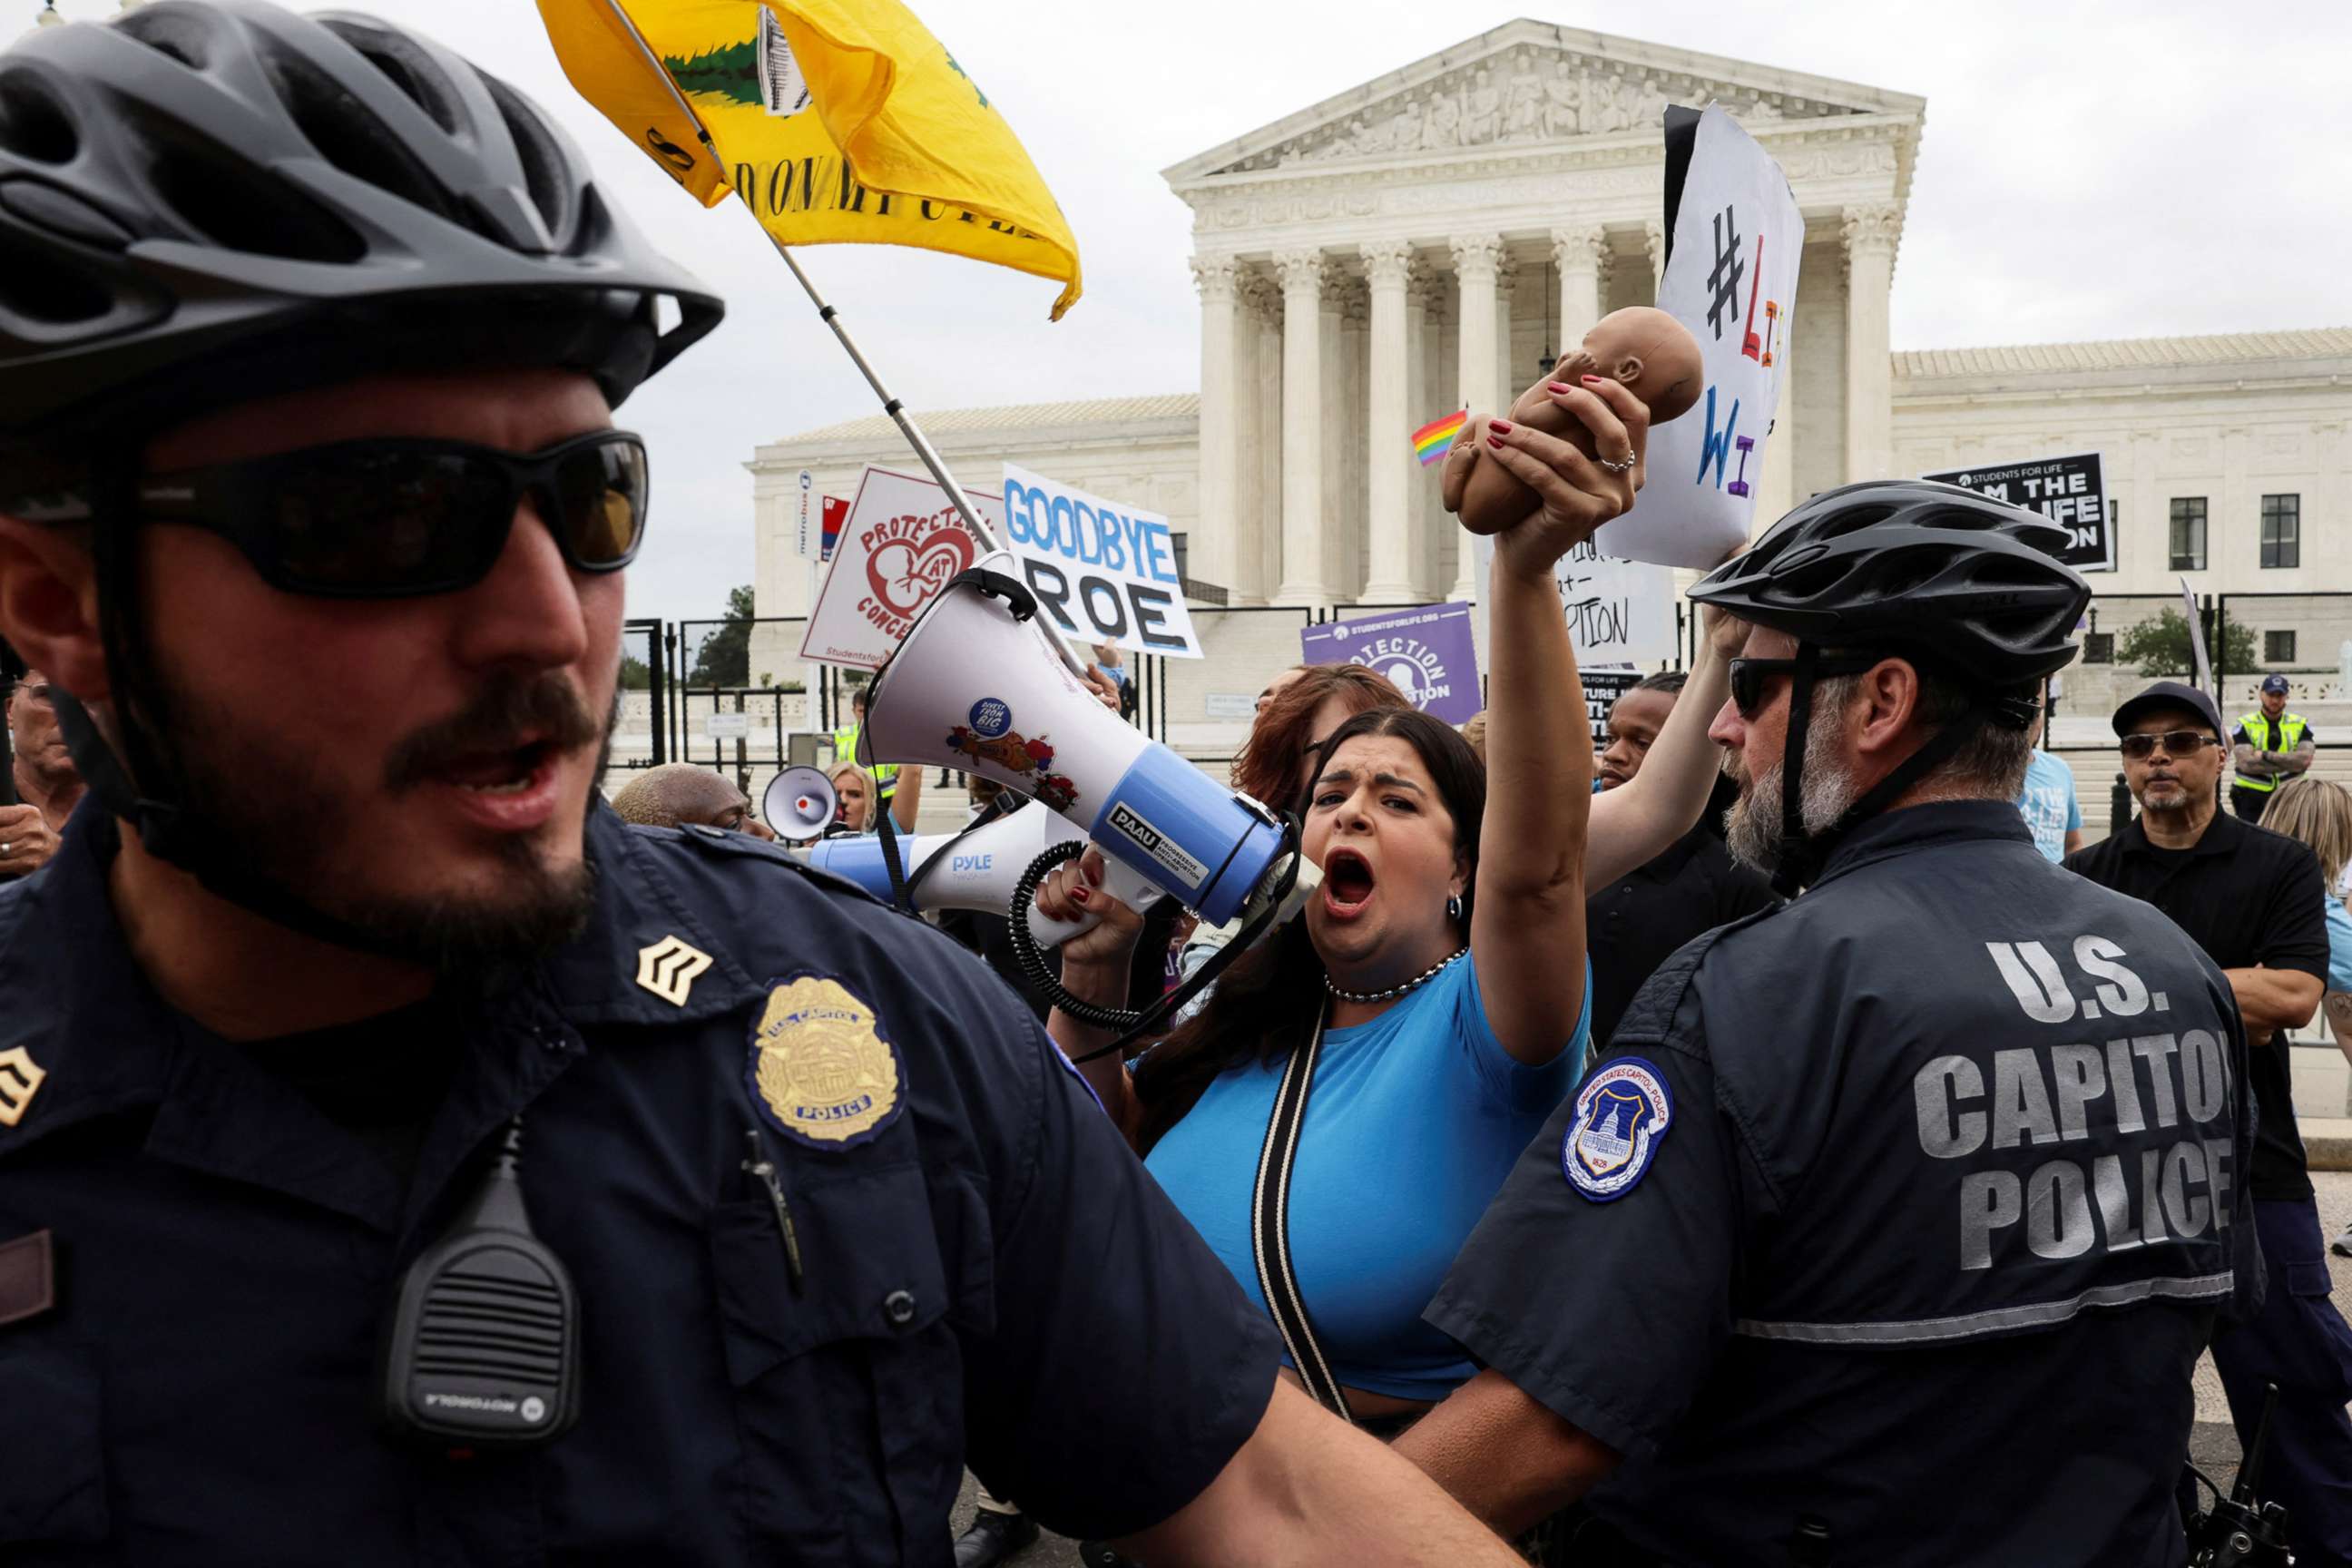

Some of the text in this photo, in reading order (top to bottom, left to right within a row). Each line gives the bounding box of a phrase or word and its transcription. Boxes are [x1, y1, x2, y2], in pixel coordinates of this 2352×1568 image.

[1973, 464, 2063, 485] STUDENTS FOR LIFE
[2023, 473, 2087, 498] THE
[2021, 495, 2101, 525] IFE
[860, 505, 995, 554] PROTECTI
[1004, 478, 1178, 584] GOODBYE
[928, 558, 951, 577] AT
[1023, 556, 1189, 651] ROE
[1351, 612, 1439, 635] STUDENTSFORLIFE.ORG
[976, 715, 1002, 728] BIG
[979, 708, 1004, 718] FROM
[1115, 810, 1156, 847] PAAU
[952, 853, 993, 872] PYLE
[1153, 850, 1181, 872] UPRISING
[1156, 846, 1200, 881] ANTI-ABORTION
[1160, 839, 1198, 871] PROGRESSIVE
[1985, 935, 2170, 1024] U.S.
[802, 1094, 870, 1120] POLICE
[1579, 1068, 1665, 1123] UNITED STATES CAPITOL POLICE
[1960, 1137, 2234, 1271] POLICE
